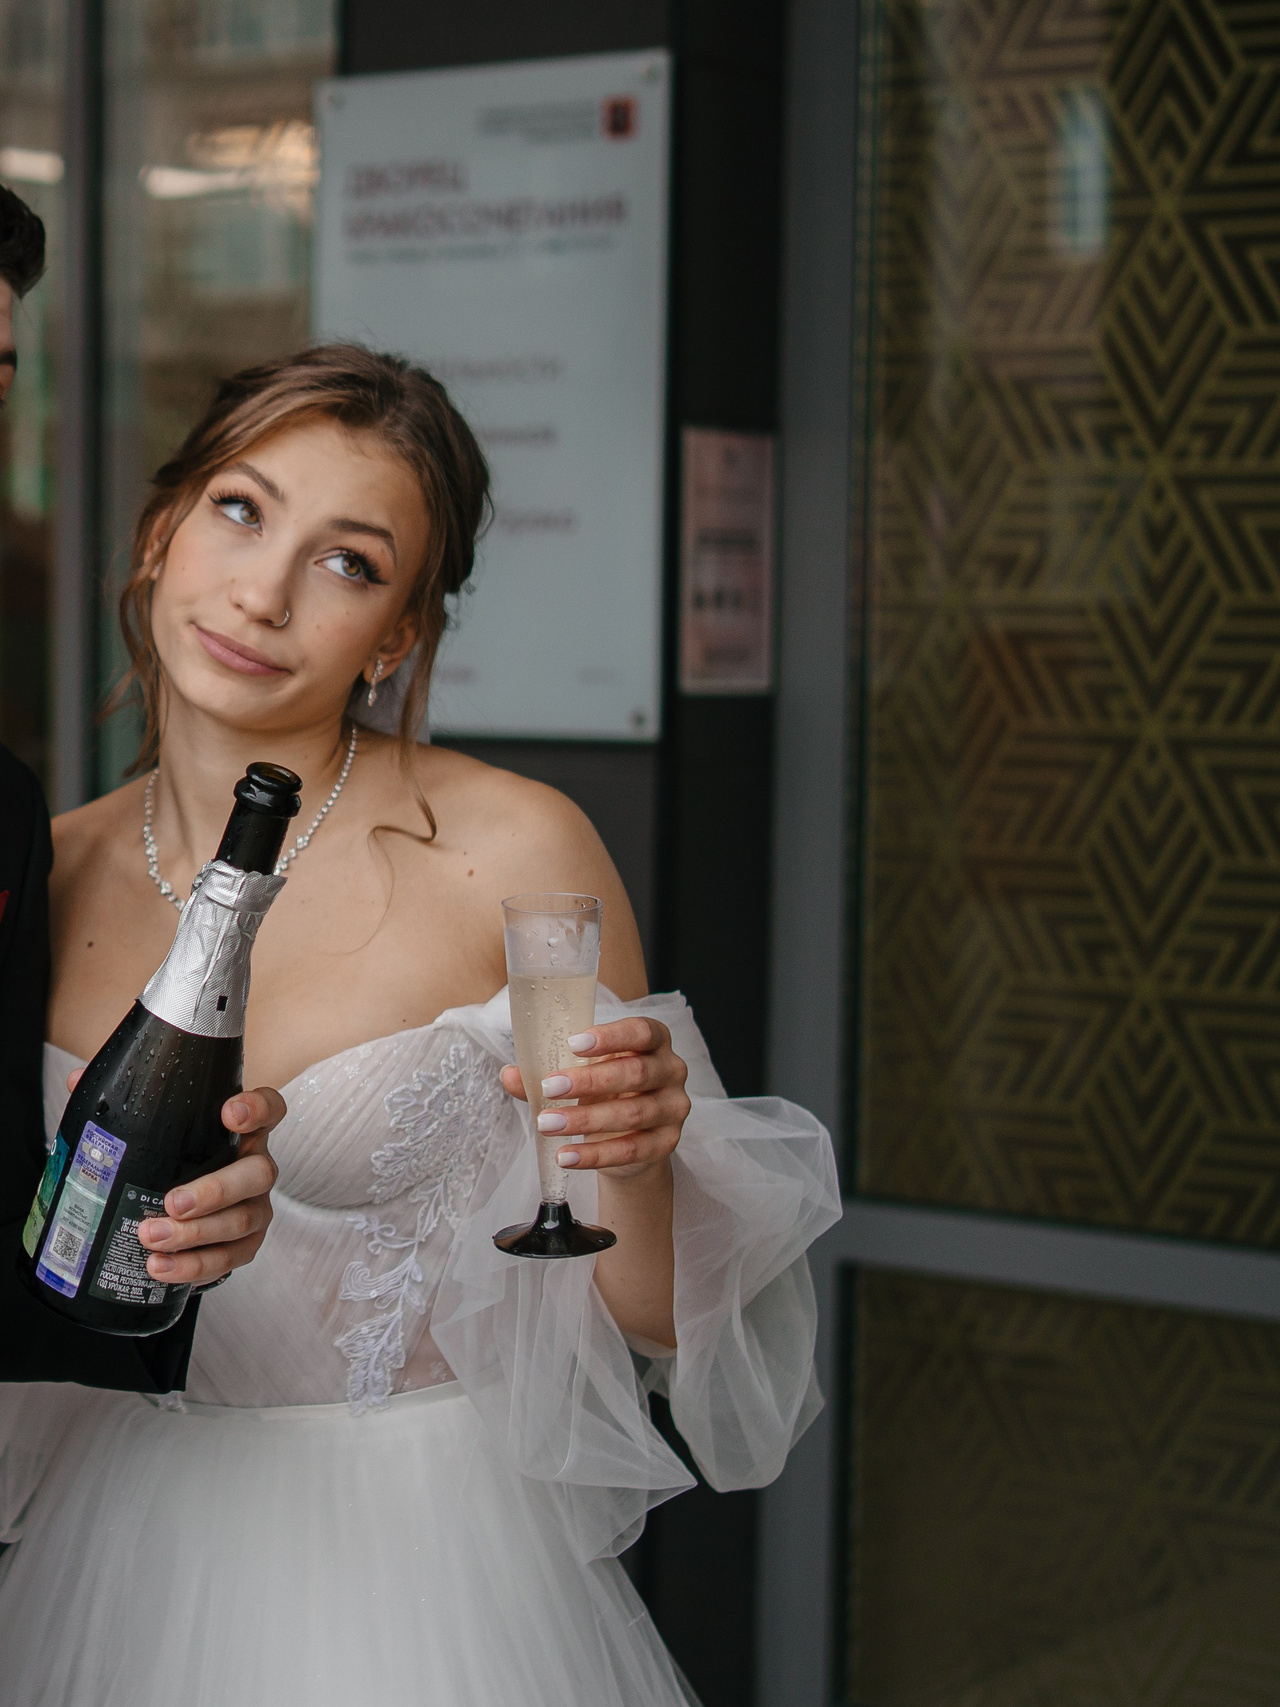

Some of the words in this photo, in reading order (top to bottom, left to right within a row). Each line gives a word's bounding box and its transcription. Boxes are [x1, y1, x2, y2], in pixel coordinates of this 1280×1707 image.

[85, 1133, 117, 1156] ФЕДЕРАЦИЯ
[87, 1129, 119, 1152] РОССИЙСКАЯ
[78, 1153, 111, 1178] ФЕДЕРАЛЬНАЯ
[81, 1168, 98, 1182] МАРКА
[140, 1194, 150, 1203] DI
[152, 1197, 164, 1206] CA
[96, 1278, 108, 1289] ГОД
